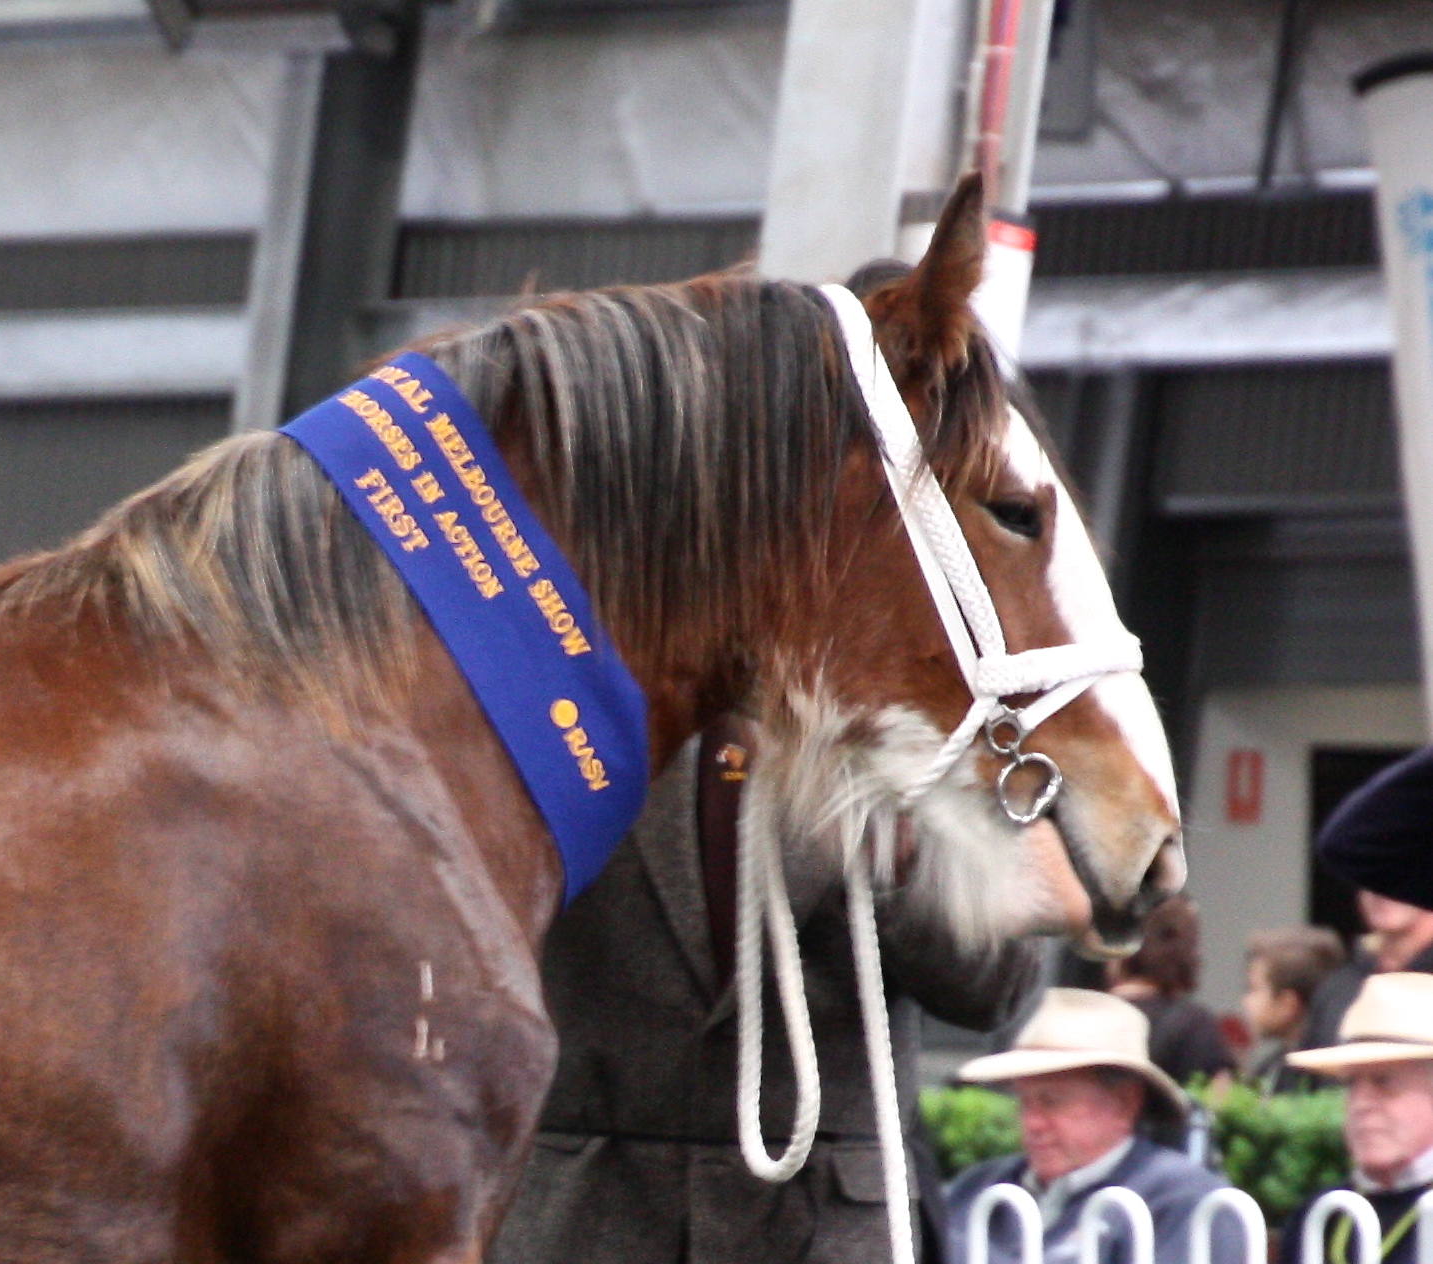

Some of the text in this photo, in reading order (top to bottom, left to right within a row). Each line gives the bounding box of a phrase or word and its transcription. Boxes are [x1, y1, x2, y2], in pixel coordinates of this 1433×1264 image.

[337, 389, 505, 599] HORSES IN ACTION
[354, 468, 429, 552] FIRST
[425, 412, 540, 578] MELBOURNE
[527, 578, 592, 656] SHOW
